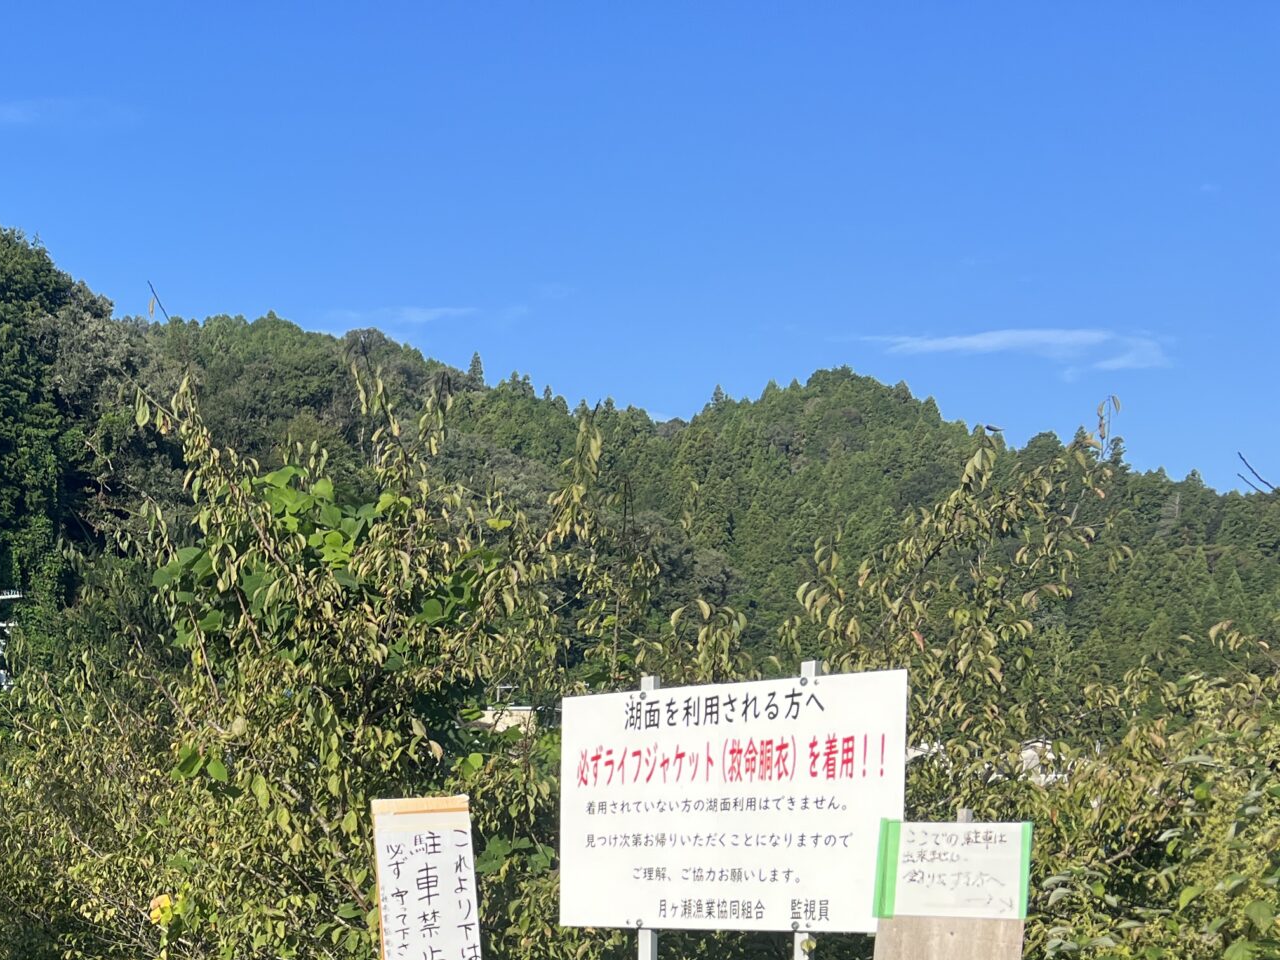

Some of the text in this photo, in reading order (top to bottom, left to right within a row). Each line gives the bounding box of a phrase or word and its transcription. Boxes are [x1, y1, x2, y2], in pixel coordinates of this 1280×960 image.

[624, 687, 825, 730] 湖面を利用される方へ
[585, 795, 848, 815] 着用されていない方の湖面利用はできません。
[585, 831, 854, 849] 見つけ次第お帰りいただくことになりますので
[631, 867, 802, 884] ご理解、ご協力お願いします。
[790, 898, 830, 922] 監視員
